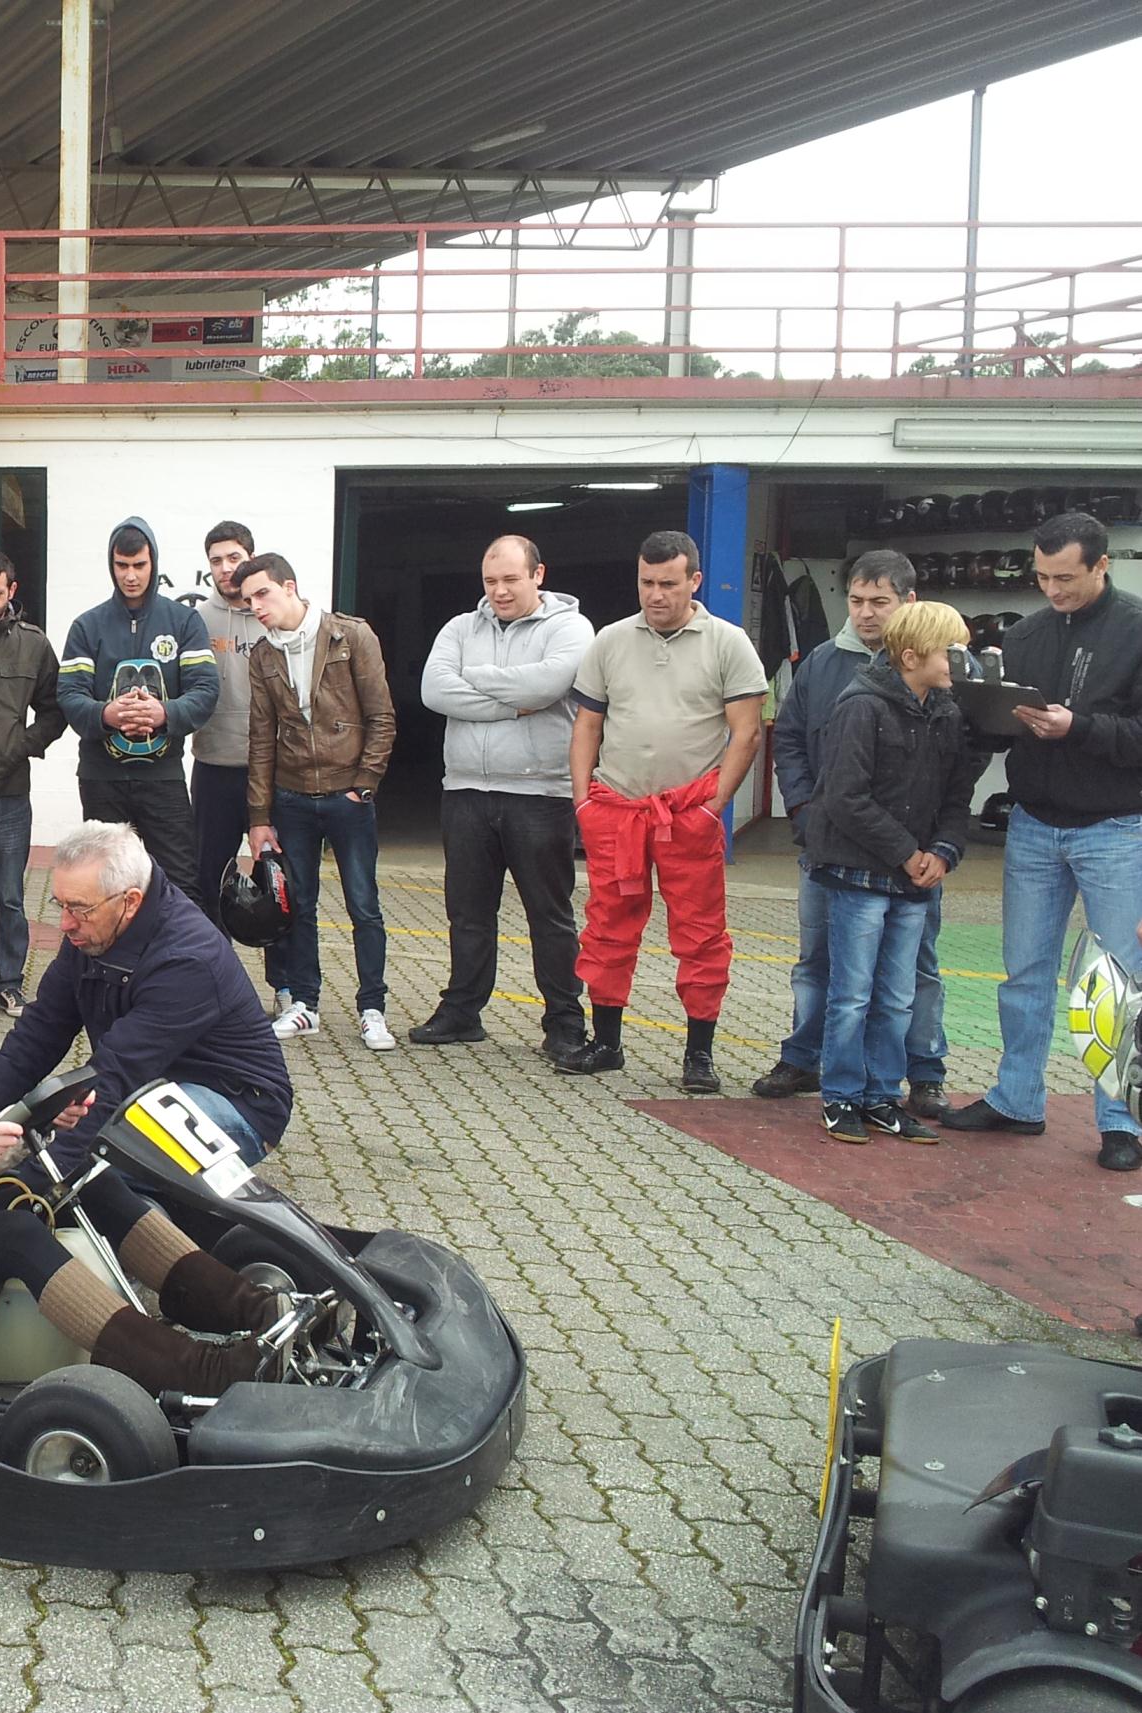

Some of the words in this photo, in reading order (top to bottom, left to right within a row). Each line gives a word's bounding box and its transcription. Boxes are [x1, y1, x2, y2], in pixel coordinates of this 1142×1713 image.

[106, 360, 150, 374] HELIX
[26, 371, 58, 380] MICHE
[157, 1094, 225, 1155] 2
